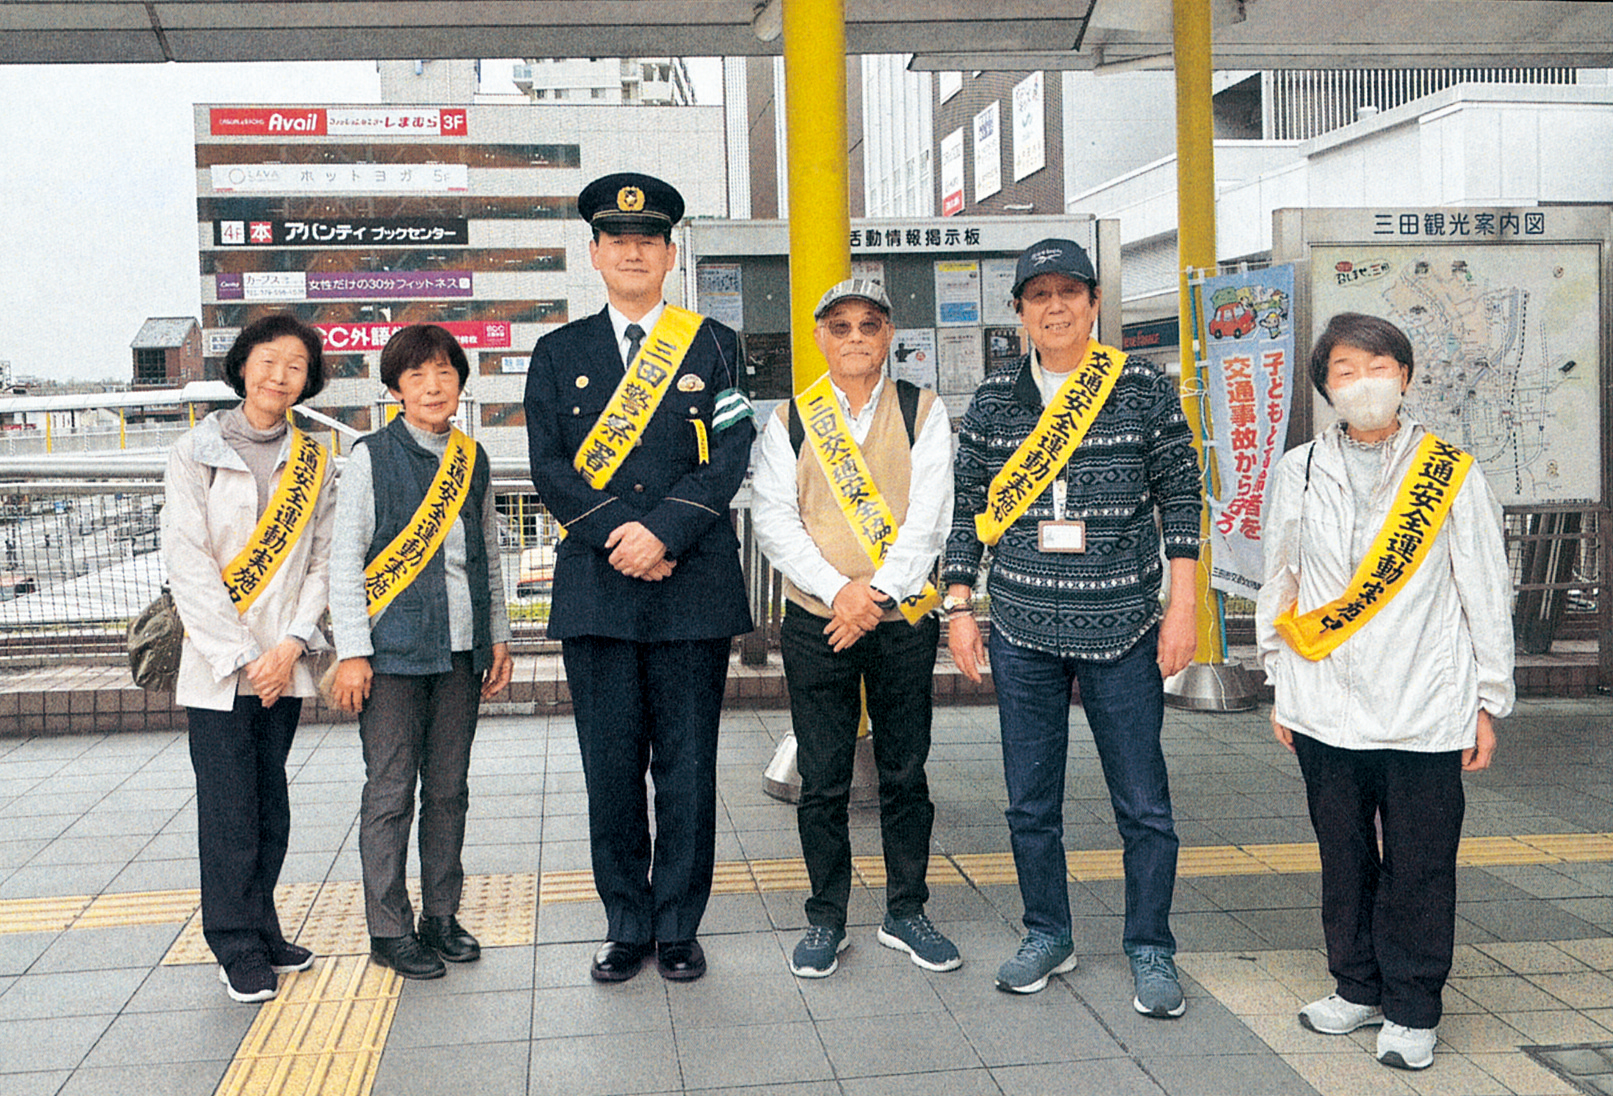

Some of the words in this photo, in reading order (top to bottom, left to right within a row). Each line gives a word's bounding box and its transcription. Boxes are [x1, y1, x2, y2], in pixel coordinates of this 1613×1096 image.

[268, 113, 317, 131] Avail
[384, 115, 438, 128] しまむら
[443, 115, 463, 129] 3F
[301, 169, 412, 183] ホットヨガ
[223, 224, 243, 240] 4F
[251, 223, 272, 242] 本
[1373, 212, 1545, 236] 三田観光案内図
[850, 228, 980, 247] 活動情報掲示板
[309, 279, 458, 290] 女性だけの30分フィットネス
[366, 445, 468, 606] 交通安全運動実施
